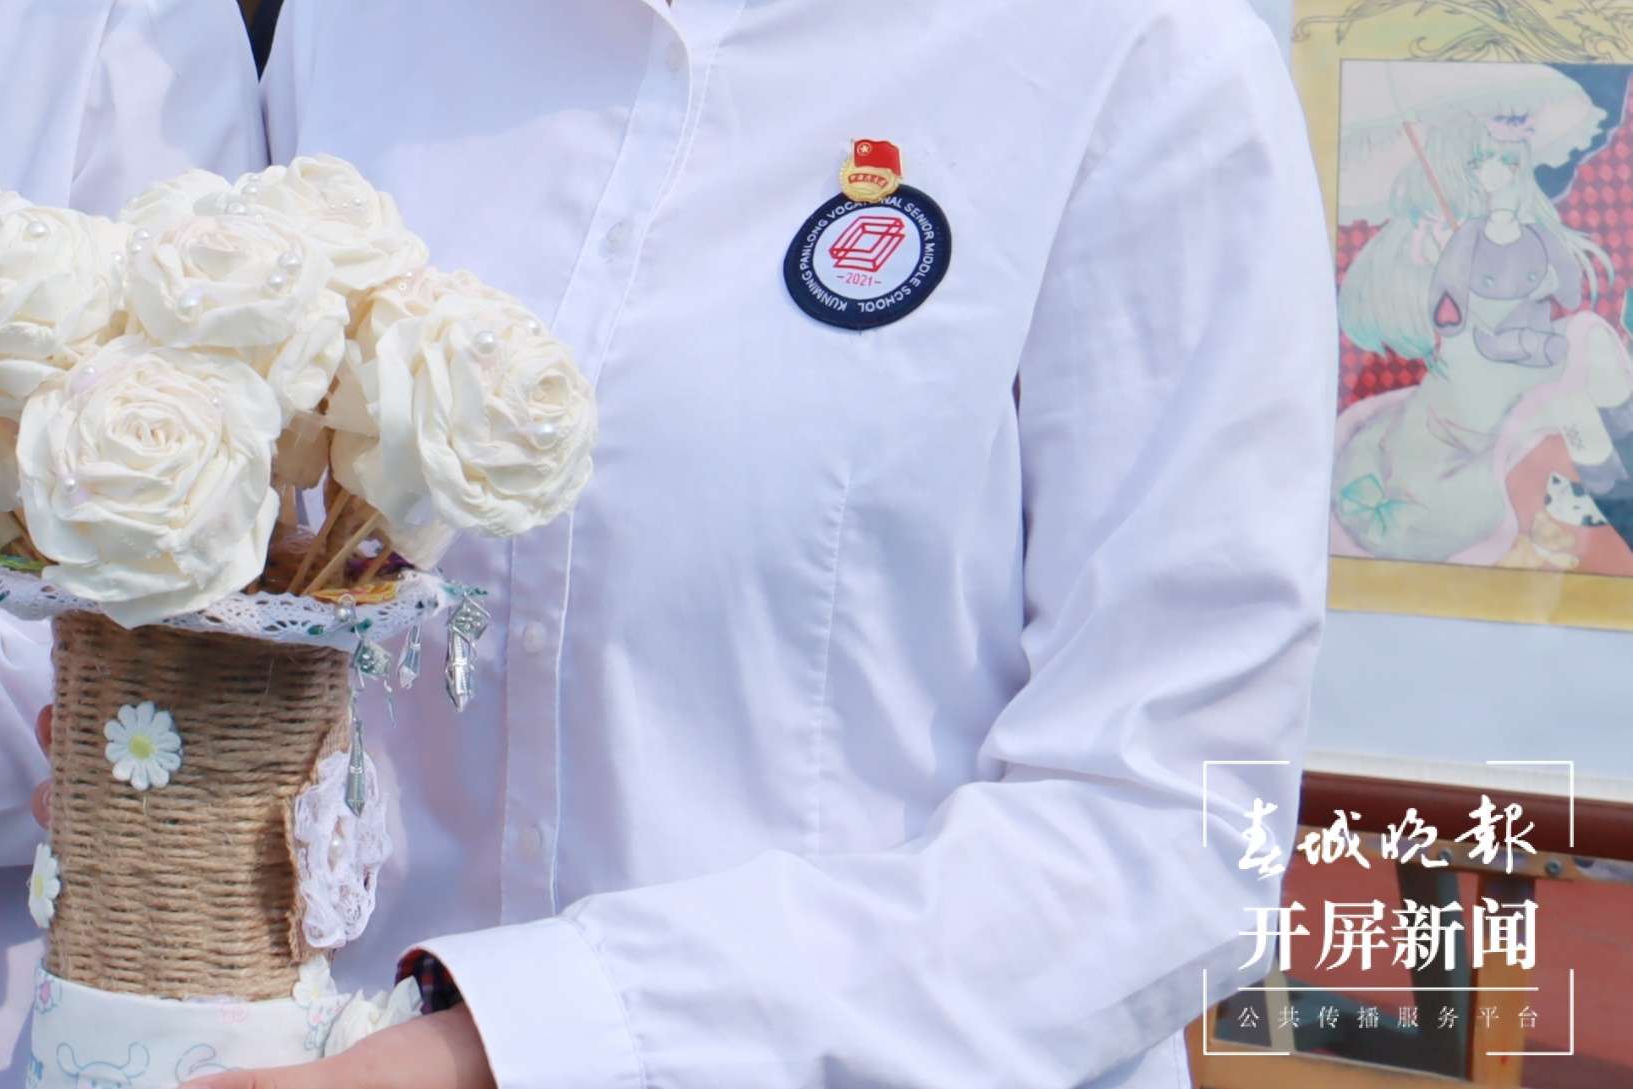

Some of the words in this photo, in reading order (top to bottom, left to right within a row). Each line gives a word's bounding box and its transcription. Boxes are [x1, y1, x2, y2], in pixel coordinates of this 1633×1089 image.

[903, 201, 935, 241] SENIOR
[799, 219, 829, 270] PANLONG
[909, 242, 935, 287] MIDDLE
[801, 273, 848, 312] KUNMING
[856, 286, 912, 312] SCHOOL
